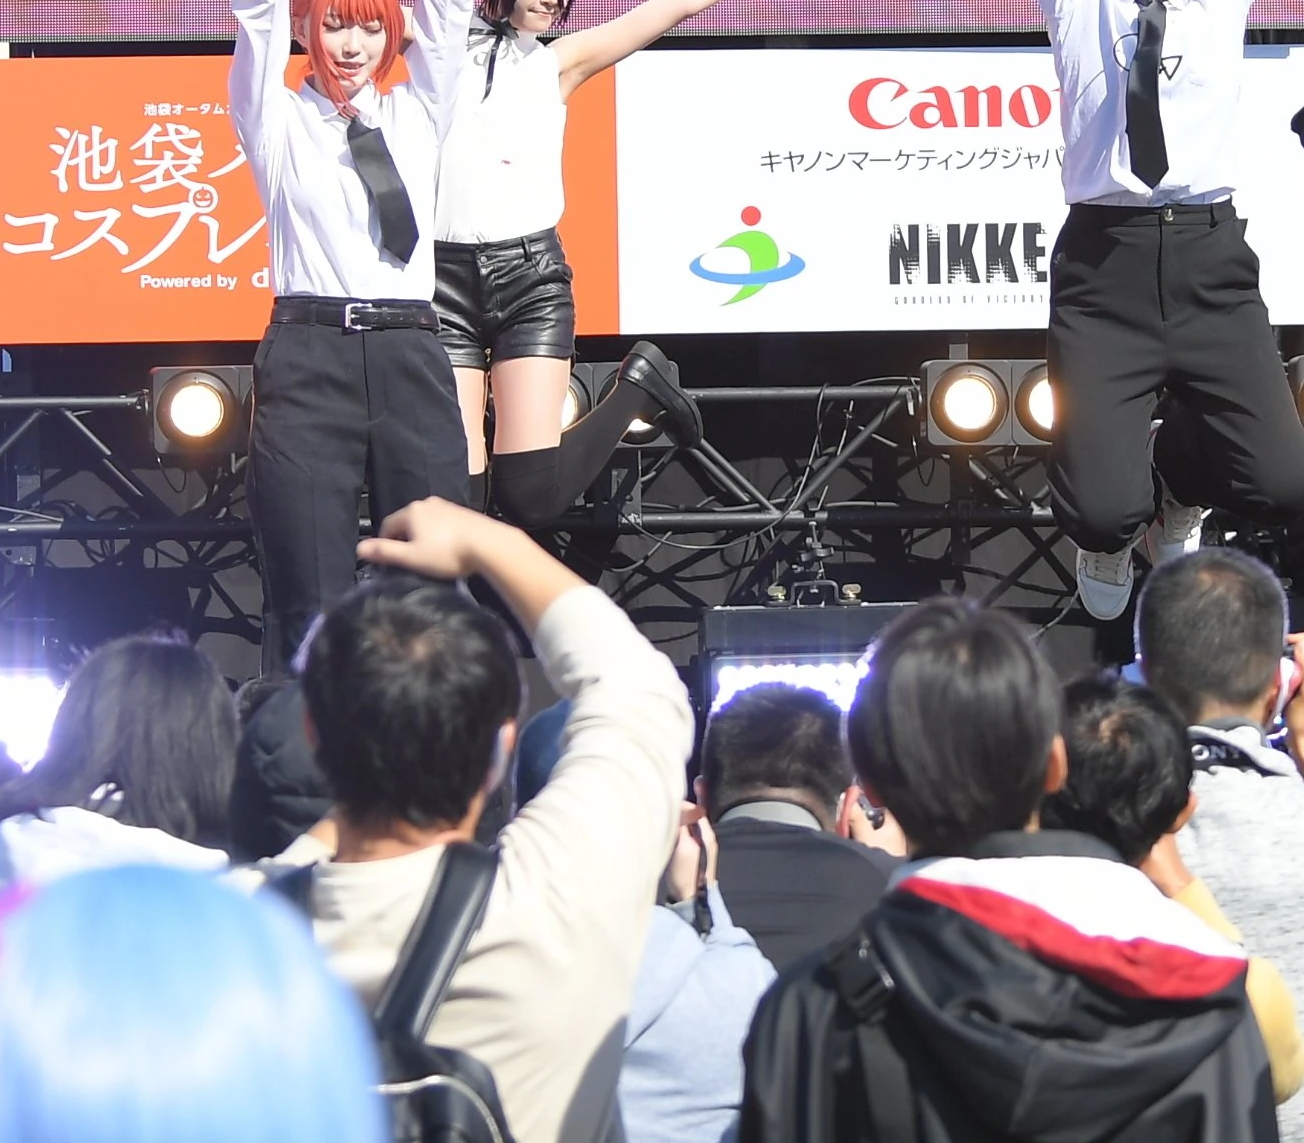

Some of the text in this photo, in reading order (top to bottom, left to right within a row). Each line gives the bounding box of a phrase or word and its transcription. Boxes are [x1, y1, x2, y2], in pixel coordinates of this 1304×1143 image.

[144, 103, 231, 117] 池袋オータム
[848, 77, 1061, 130] Cano
[888, 222, 1048, 285] NIKKE
[140, 274, 212, 289] Powered
[216, 273, 238, 290] by
